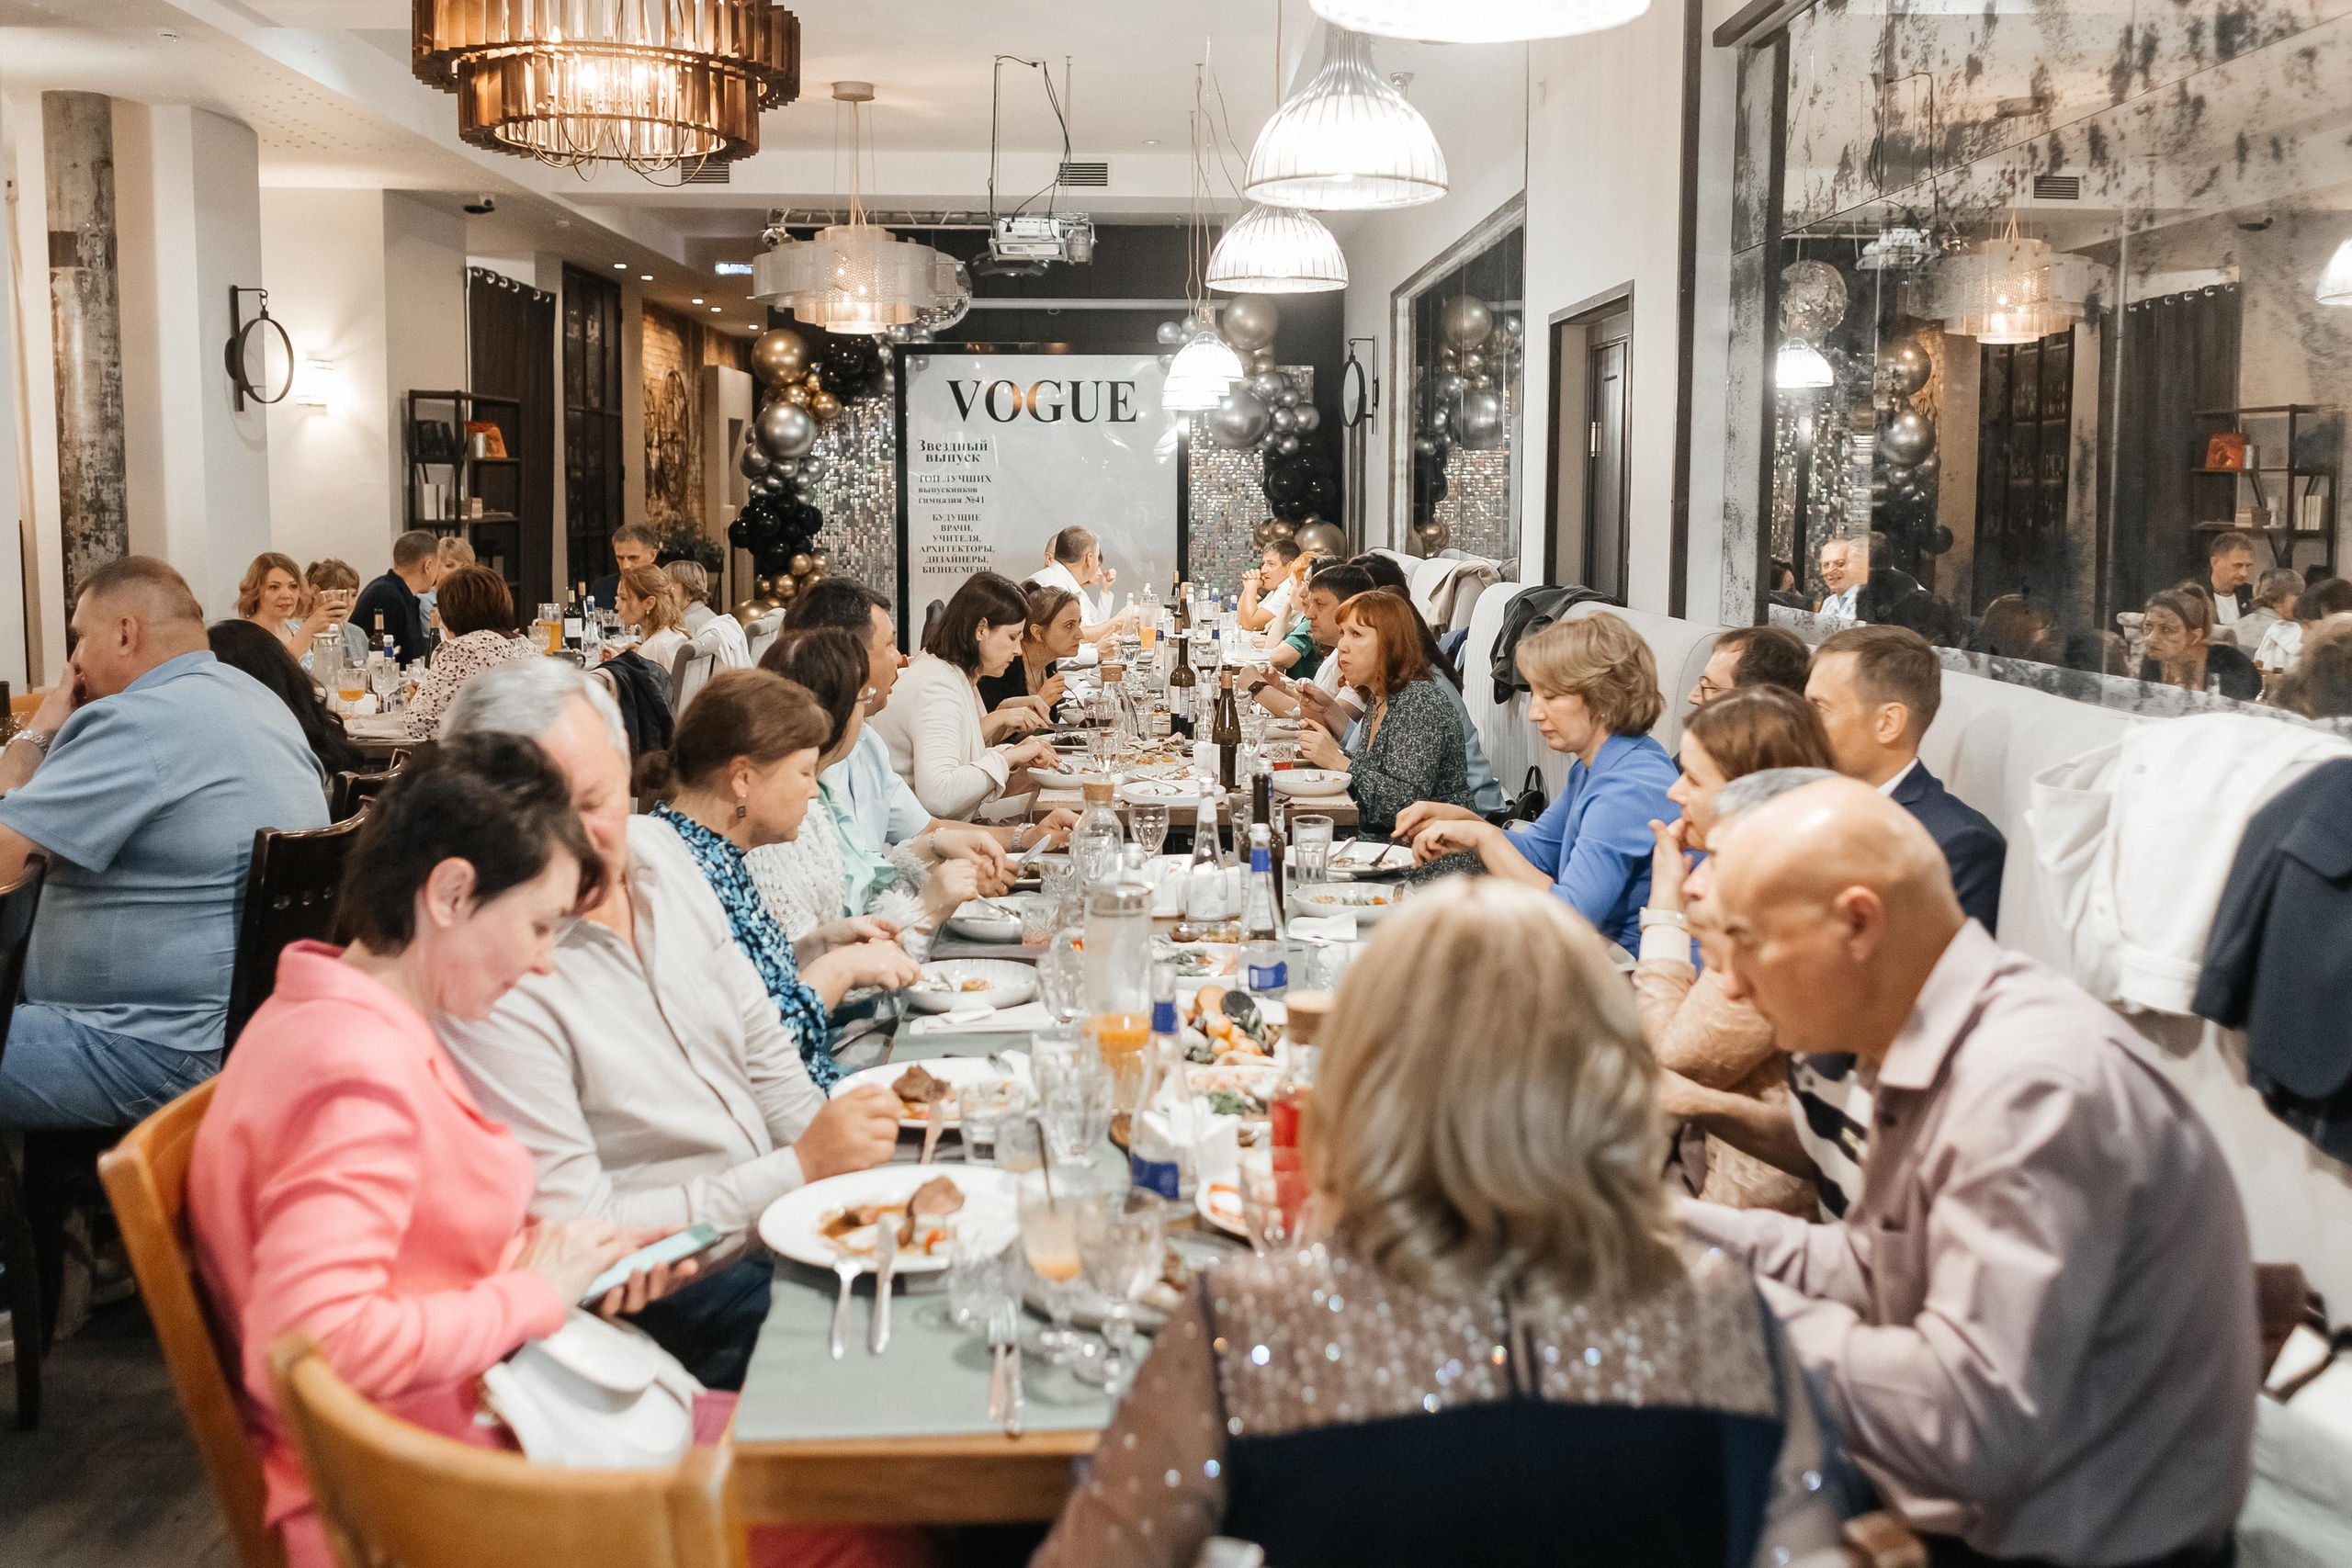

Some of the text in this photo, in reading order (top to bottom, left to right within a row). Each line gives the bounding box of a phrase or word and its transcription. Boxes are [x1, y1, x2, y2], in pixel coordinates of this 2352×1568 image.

[945, 378, 1138, 423] VOGUE
[917, 439, 989, 452] Звездный
[925, 454, 981, 466] выпуск
[920, 474, 992, 483] ТОП ЛУЧШИХ
[918, 487, 978, 495] выпускников
[964, 495, 985, 504] №41
[932, 513, 981, 523] БУДУЩИЕ
[940, 524, 974, 532] ВРАЧИ,
[932, 534, 982, 543] УЧИТЕЛЯ,
[920, 545, 996, 553] АРХИТЕКТОРЫ,
[924, 554, 989, 564] ДИЗАЙНЕРЫ,
